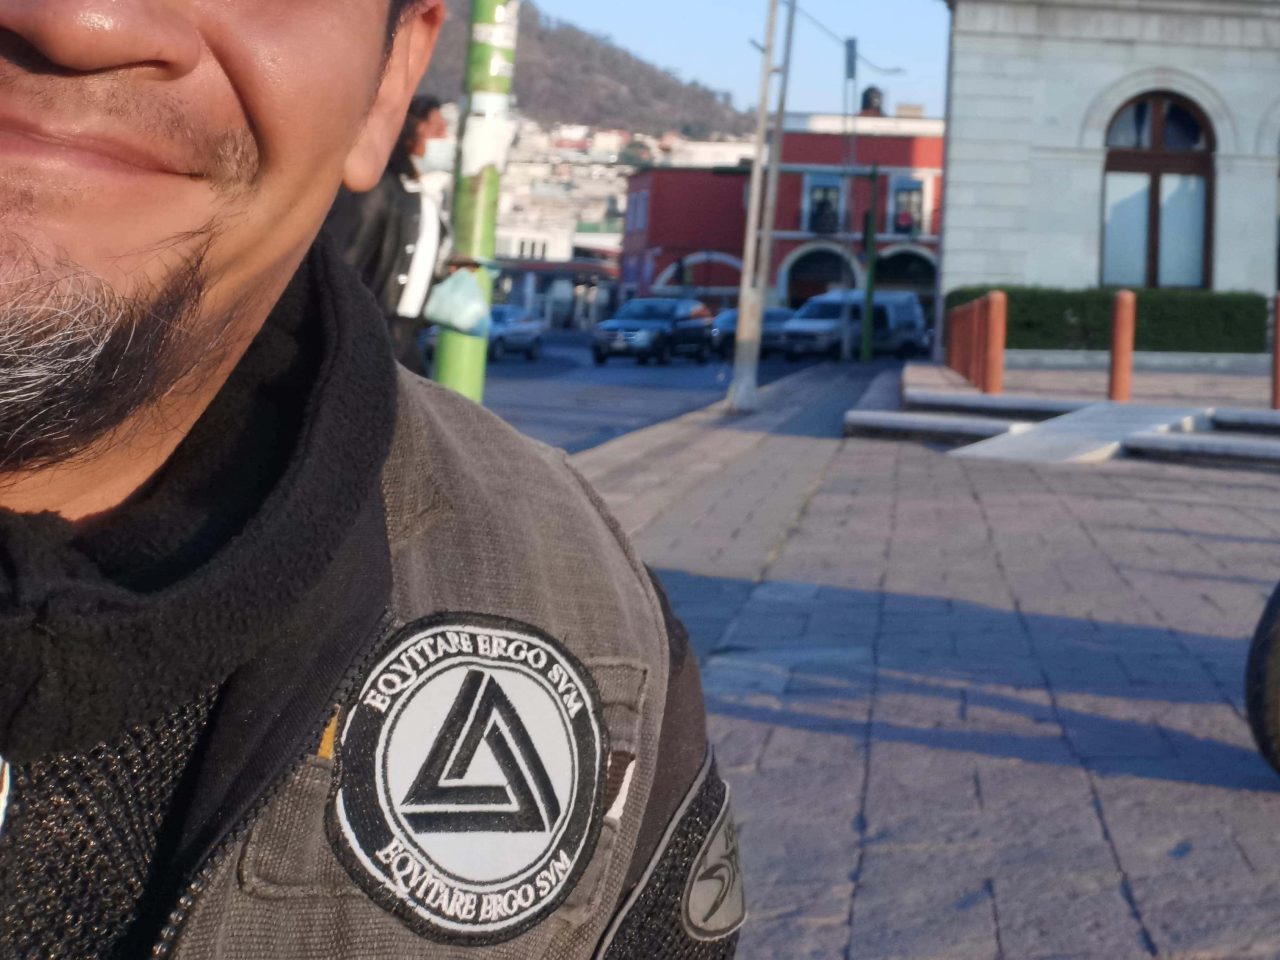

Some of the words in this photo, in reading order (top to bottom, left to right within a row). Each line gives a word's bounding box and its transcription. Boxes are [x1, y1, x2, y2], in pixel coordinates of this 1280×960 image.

[363, 631, 473, 713] EQVITARE
[477, 635, 547, 669] ERGO
[548, 663, 584, 719] SVM
[376, 839, 476, 921] EQVITARE
[479, 884, 535, 921] ERGO
[535, 849, 571, 897] SVM
